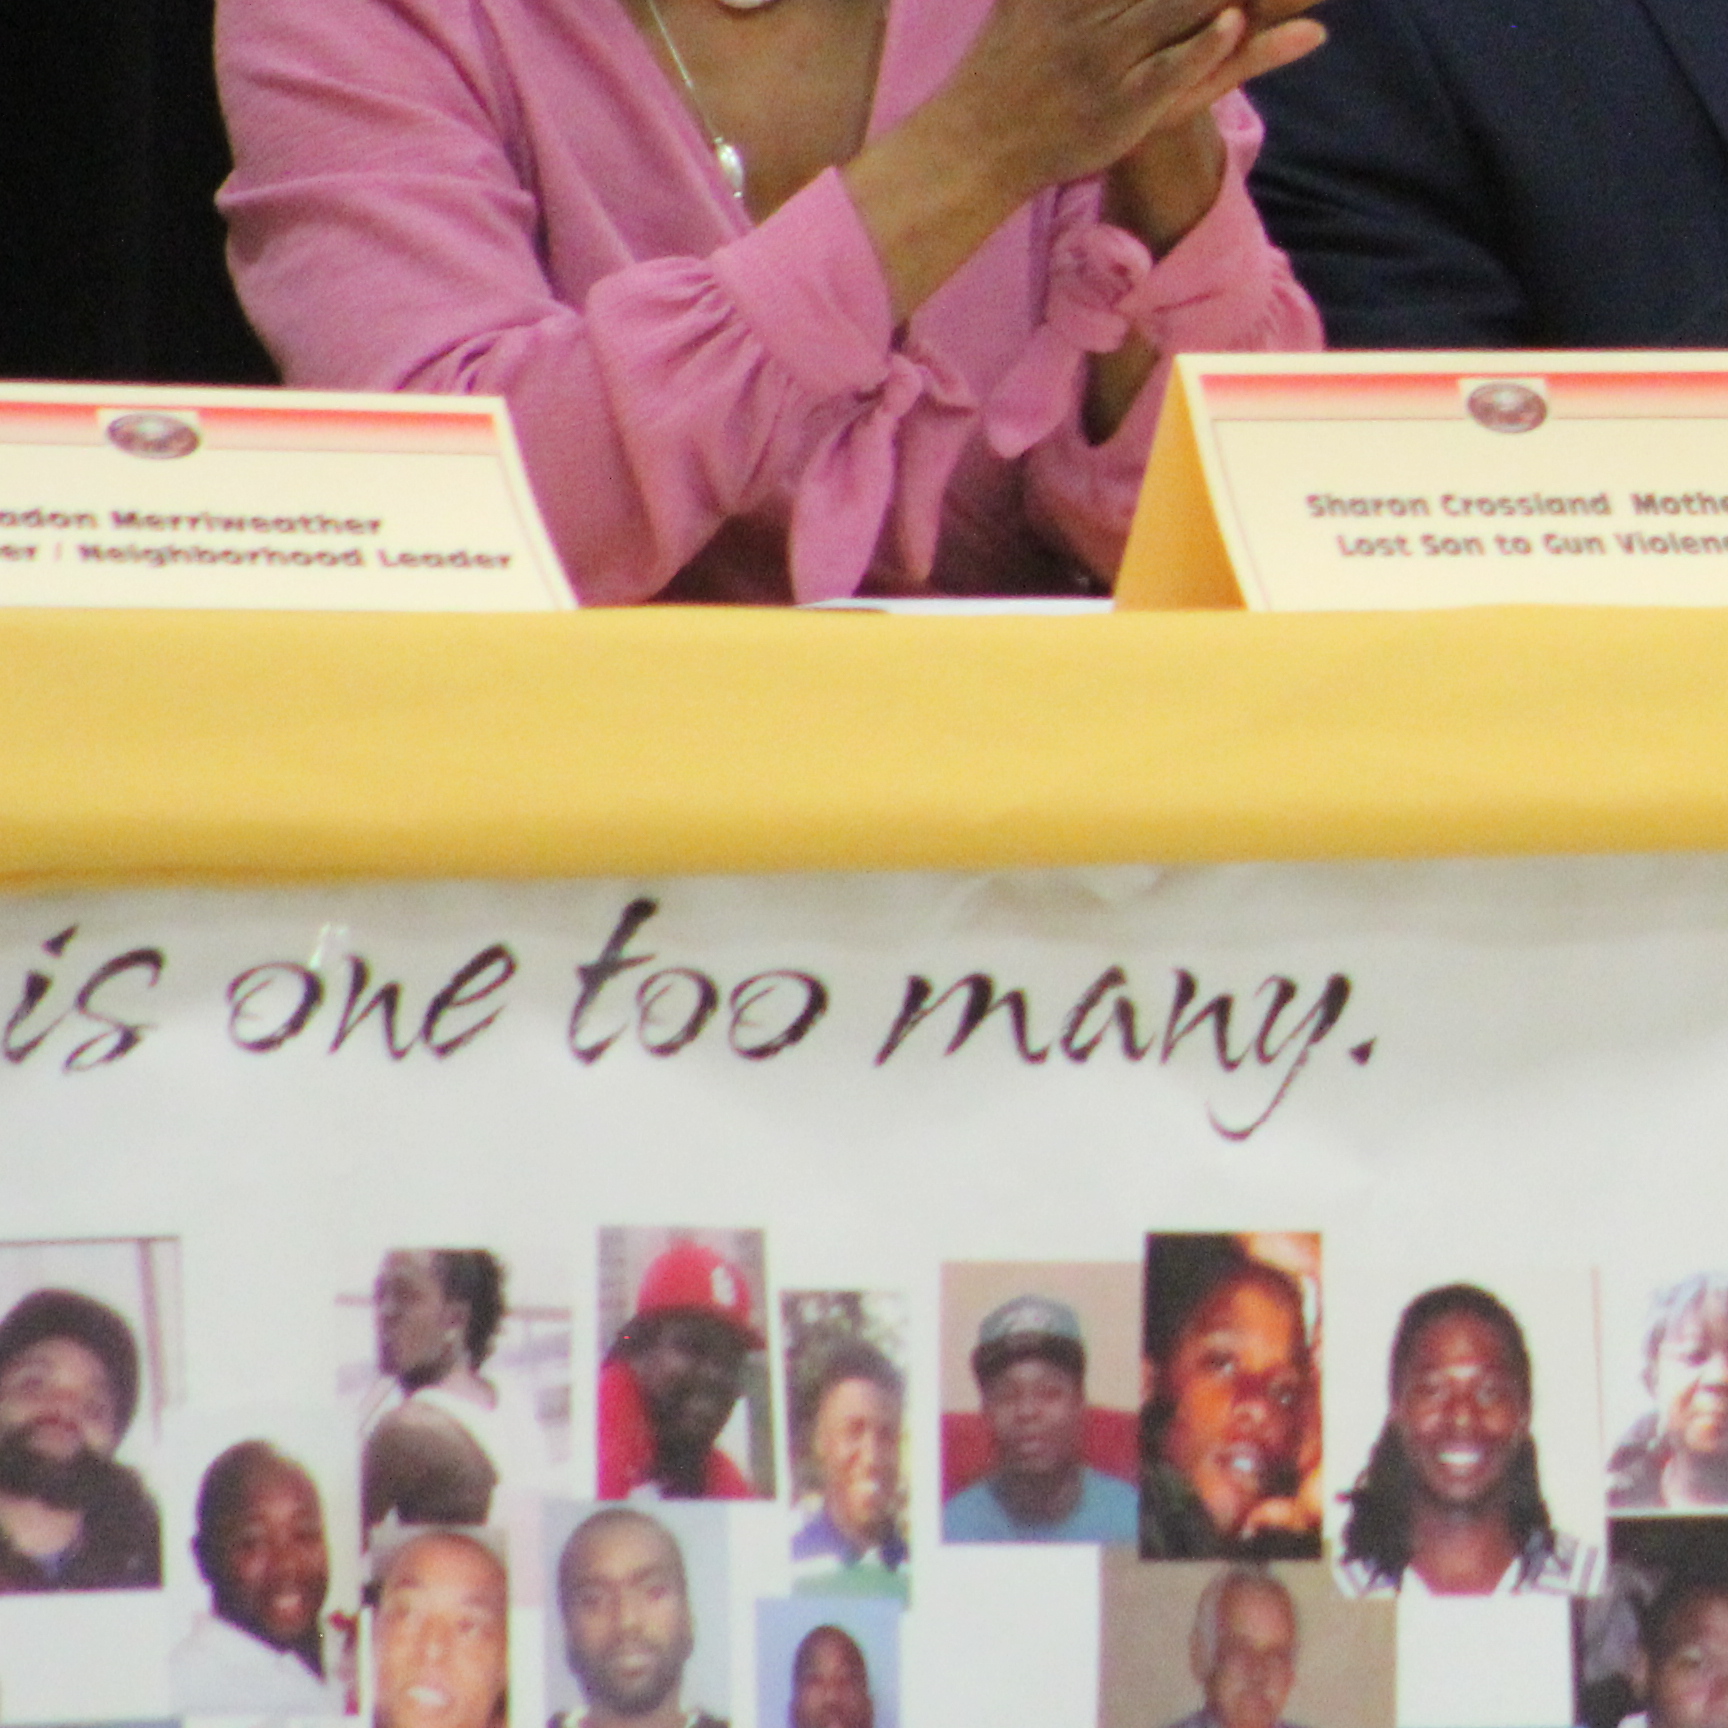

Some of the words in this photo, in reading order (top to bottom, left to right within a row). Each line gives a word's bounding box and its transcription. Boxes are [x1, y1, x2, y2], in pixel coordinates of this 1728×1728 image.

[1304, 493, 1431, 519] Sharon
[109, 509, 382, 535] Merriweather
[76, 542, 365, 568] Neighborhood
[376, 548, 512, 570] Leader
[1335, 534, 1413, 558] Lost
[1419, 532, 1486, 557] Son
[1493, 533, 1534, 557] to
[1541, 532, 1607, 556] Gun
[1, 921, 166, 1070] is
[225, 942, 519, 1062] one
[568, 892, 831, 1066] too
[873, 964, 1376, 1142] many.
